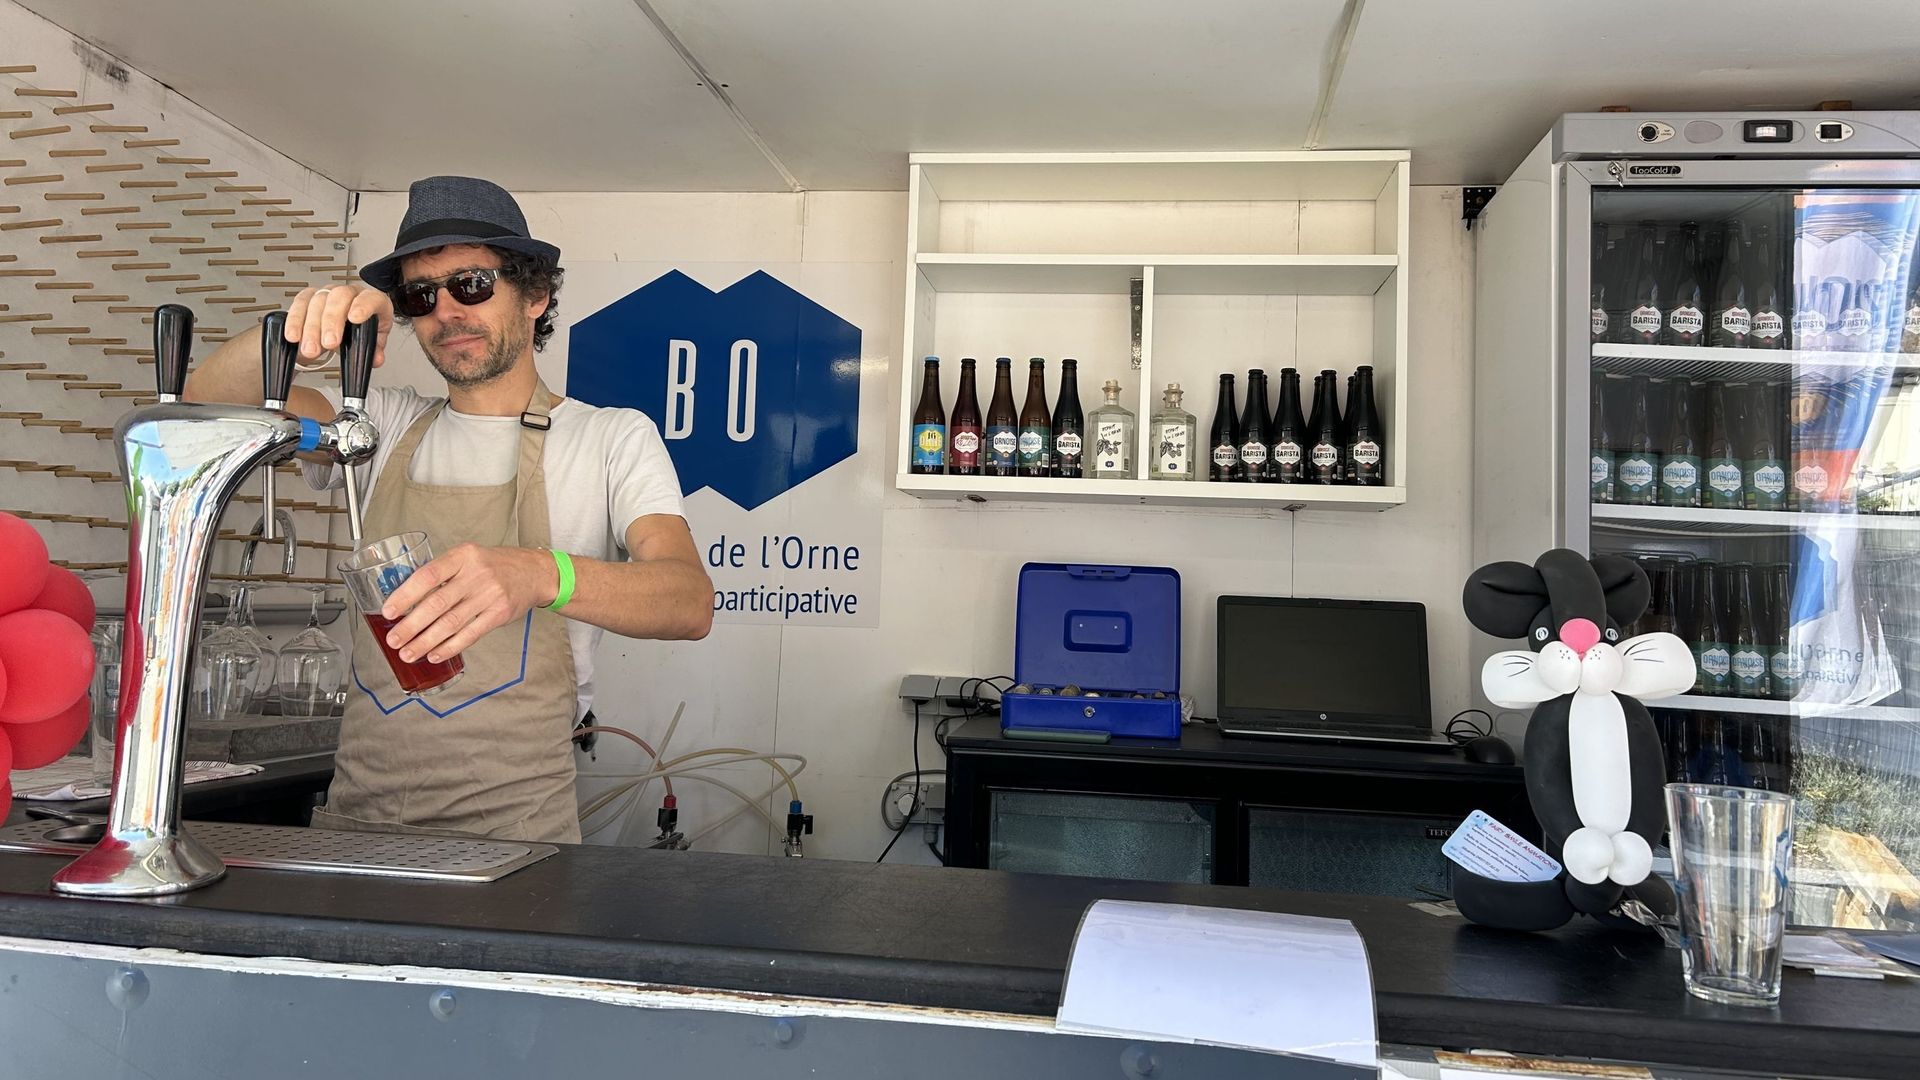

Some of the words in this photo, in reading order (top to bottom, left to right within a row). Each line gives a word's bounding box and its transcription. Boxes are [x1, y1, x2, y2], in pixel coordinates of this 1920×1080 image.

[1632, 316, 1660, 325] BARISTA
[1671, 316, 1703, 326] BARISTA
[1724, 317, 1750, 327] BARISTA
[1793, 319, 1824, 330] BARISTA
[1751, 322, 1781, 331] BARISTA
[664, 339, 697, 440] B
[726, 339, 758, 443] O
[1057, 440, 1081, 449] BARISTA
[1215, 453, 1237, 461] BARISTA
[1242, 450, 1266, 458] BARISTA
[1276, 450, 1300, 458] BARISTA
[1313, 452, 1336, 460] BARISTA
[1354, 449, 1379, 458] BARISTA
[709, 535, 745, 568] de
[761, 535, 860, 571] l'Orne
